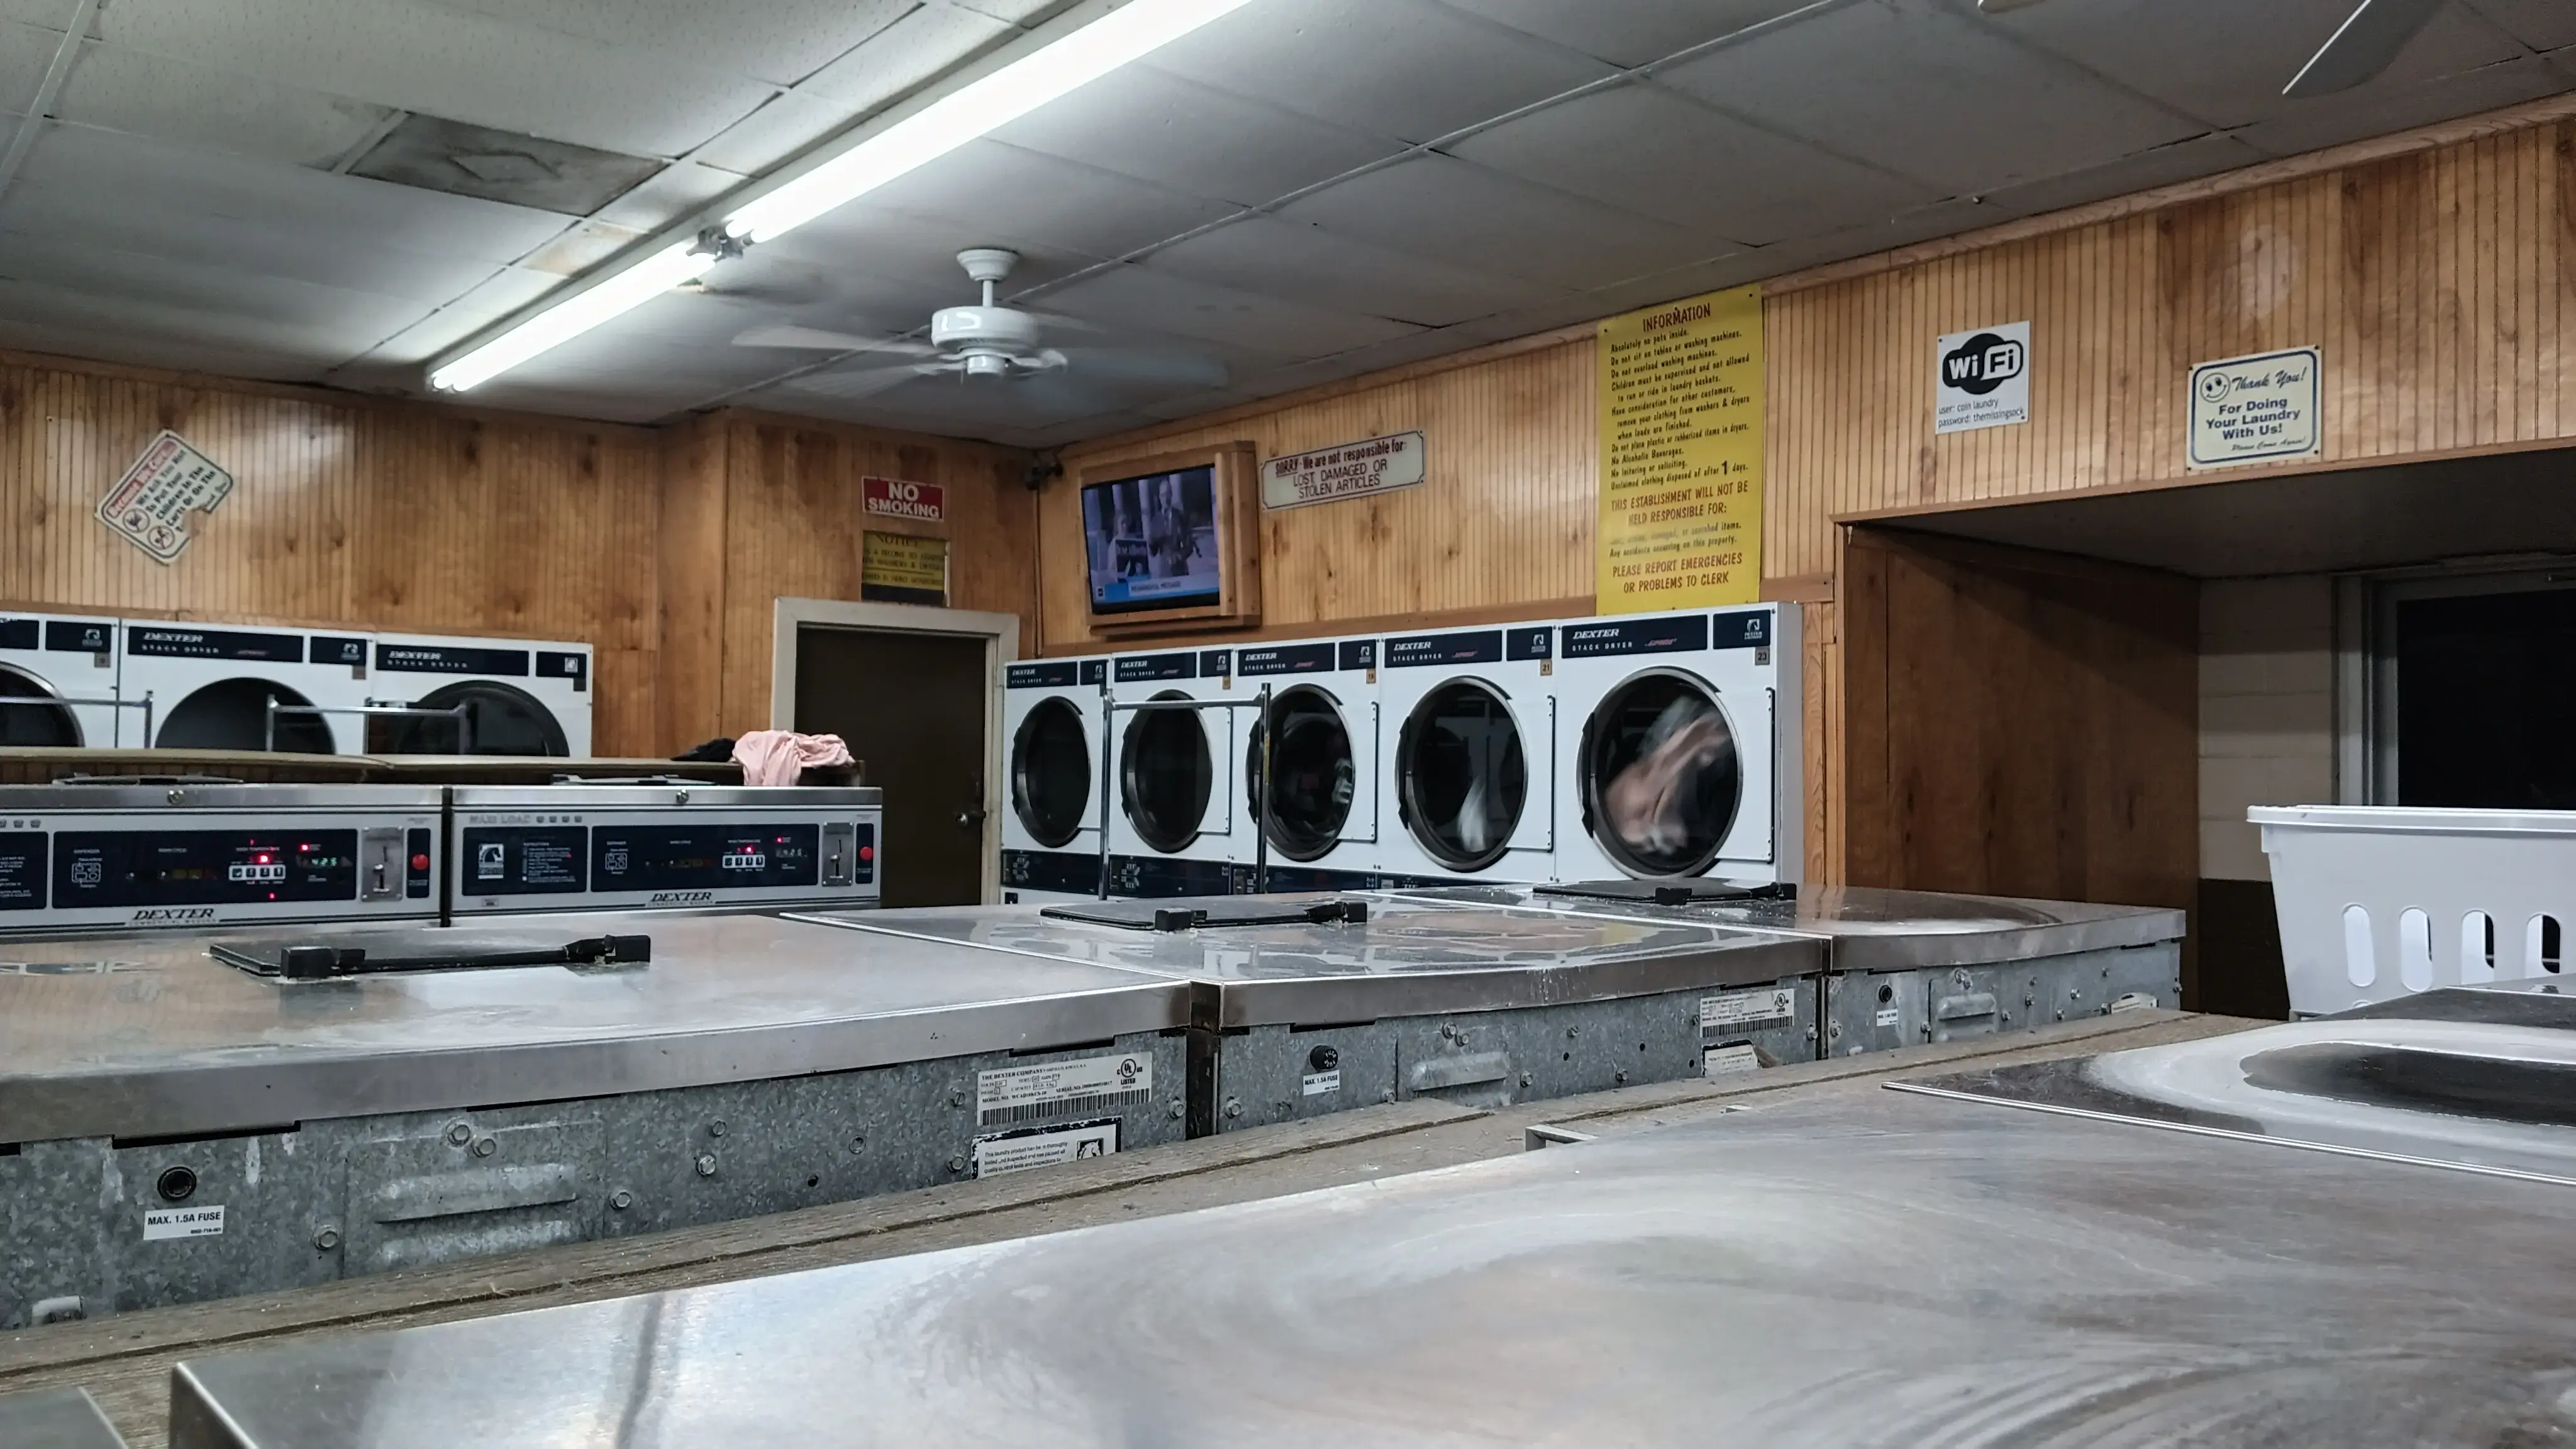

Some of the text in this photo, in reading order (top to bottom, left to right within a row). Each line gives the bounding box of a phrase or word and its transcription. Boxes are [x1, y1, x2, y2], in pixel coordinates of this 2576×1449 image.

[1643, 302, 1710, 333] INFORMATION
[1611, 333, 1666, 353] Absolutely pets
[1611, 357, 1618, 365] Do
[1621, 355, 1630, 363] not
[1654, 345, 1672, 355] tables
[1684, 337, 1707, 348] washing
[1711, 330, 1741, 342] machines.
[1611, 350, 1718, 378] Do not overload washing machines.
[1611, 353, 1749, 391] Children must supervised and not allowed
[1648, 387, 1658, 396] ride
[1670, 380, 1692, 391] laundry
[1696, 375, 1721, 386] baskets.
[2231, 366, 2307, 391] Thank You!
[1611, 386, 1735, 416] Have consideration for other customers,
[1938, 397, 1999, 414] user: coin laundry
[2219, 398, 2288, 415] For Doing
[1618, 396, 1749, 427] remove your clothing from washers & dryers
[2206, 409, 2301, 429] Your Laundry
[1618, 431, 1631, 440] when
[1635, 427, 1650, 436] loads
[1666, 418, 1691, 431] finished.
[1938, 415, 1971, 429] password:
[2223, 423, 2282, 440] With Us!
[1612, 443, 1618, 452] Do
[1631, 441, 1644, 451] place
[1647, 438, 1664, 448] plastic
[1675, 429, 1702, 441] rubberized
[1730, 423, 1748, 433] dryers.
[1314, 456, 1326, 467] are
[1328, 449, 1340, 464] not
[1344, 440, 1389, 462] responsible
[1611, 448, 1684, 465] No Alcoholic Beverages.
[201, 470, 216, 484] The
[1294, 458, 1387, 487] LOST DAMAGED OR
[1611, 460, 1687, 477] No loitering soliciting.
[1611, 460, 1748, 490] Unclaimed clothing disposed after 1 days.
[156, 489, 184, 520] Children
[189, 466, 204, 480] The
[888, 482, 919, 502] NO
[1299, 473, 1380, 499] STOLEN ARTICLES
[1612, 480, 1748, 511] THIS ESTABLISHMENT WILL NOT BE
[154, 489, 169, 504] Put
[868, 497, 940, 519] SMOKING
[1628, 502, 1726, 526] HELD RESPONSIBLE FOR:
[1721, 522, 1741, 530] items.
[1609, 535, 1736, 558] Any this property.
[1613, 552, 1742, 577] PLEASE REPORT EMERGENCIES
[1623, 570, 1729, 593] OR PROBLEMS TO CLERK
[143, 631, 203, 643] DEXTER
[1573, 628, 1619, 640] DEXTER
[389, 650, 441, 660] DEXTER
[1394, 641, 1431, 651] DEXTER
[1572, 641, 1633, 652] STACK DRYER
[1121, 660, 1148, 669] DEXTER
[1245, 652, 1277, 661] DEXTER
[650, 892, 712, 902] DEXTER
[133, 908, 214, 920] DEXTER
[1016, 1069, 1043, 1077] COMPANY
[148, 1211, 221, 1225] MAX. 1.5A FUSE
